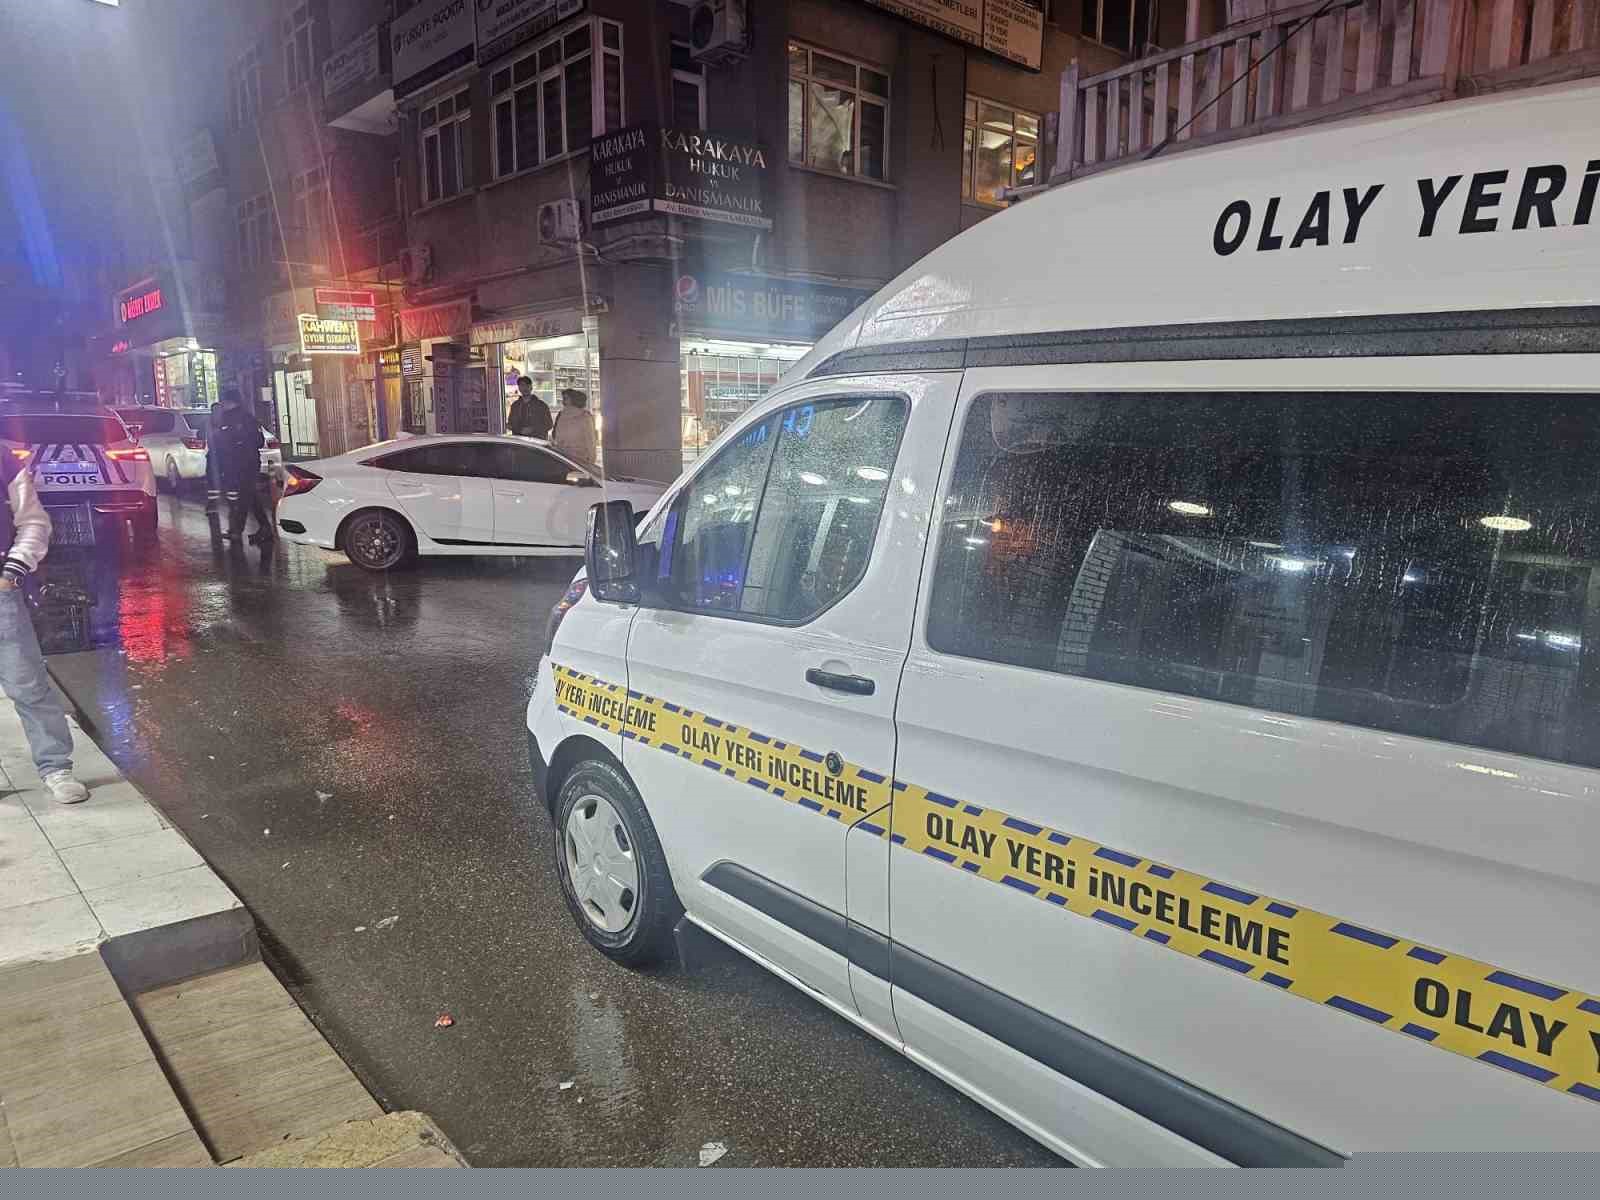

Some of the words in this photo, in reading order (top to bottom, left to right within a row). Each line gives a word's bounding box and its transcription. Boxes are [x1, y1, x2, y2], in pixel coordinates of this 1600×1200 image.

[592, 128, 646, 161] KARAKAYA
[660, 127, 766, 169] KARAKAYA
[604, 158, 633, 177] HUKUK
[690, 157, 741, 181] HUKUK
[1212, 183, 1386, 257] OLAY
[706, 282, 746, 315] MİS
[752, 288, 804, 321] BÜFE
[681, 723, 720, 756] OLAY
[925, 812, 998, 859] OLAY
[1414, 977, 1569, 1057] OLAY
